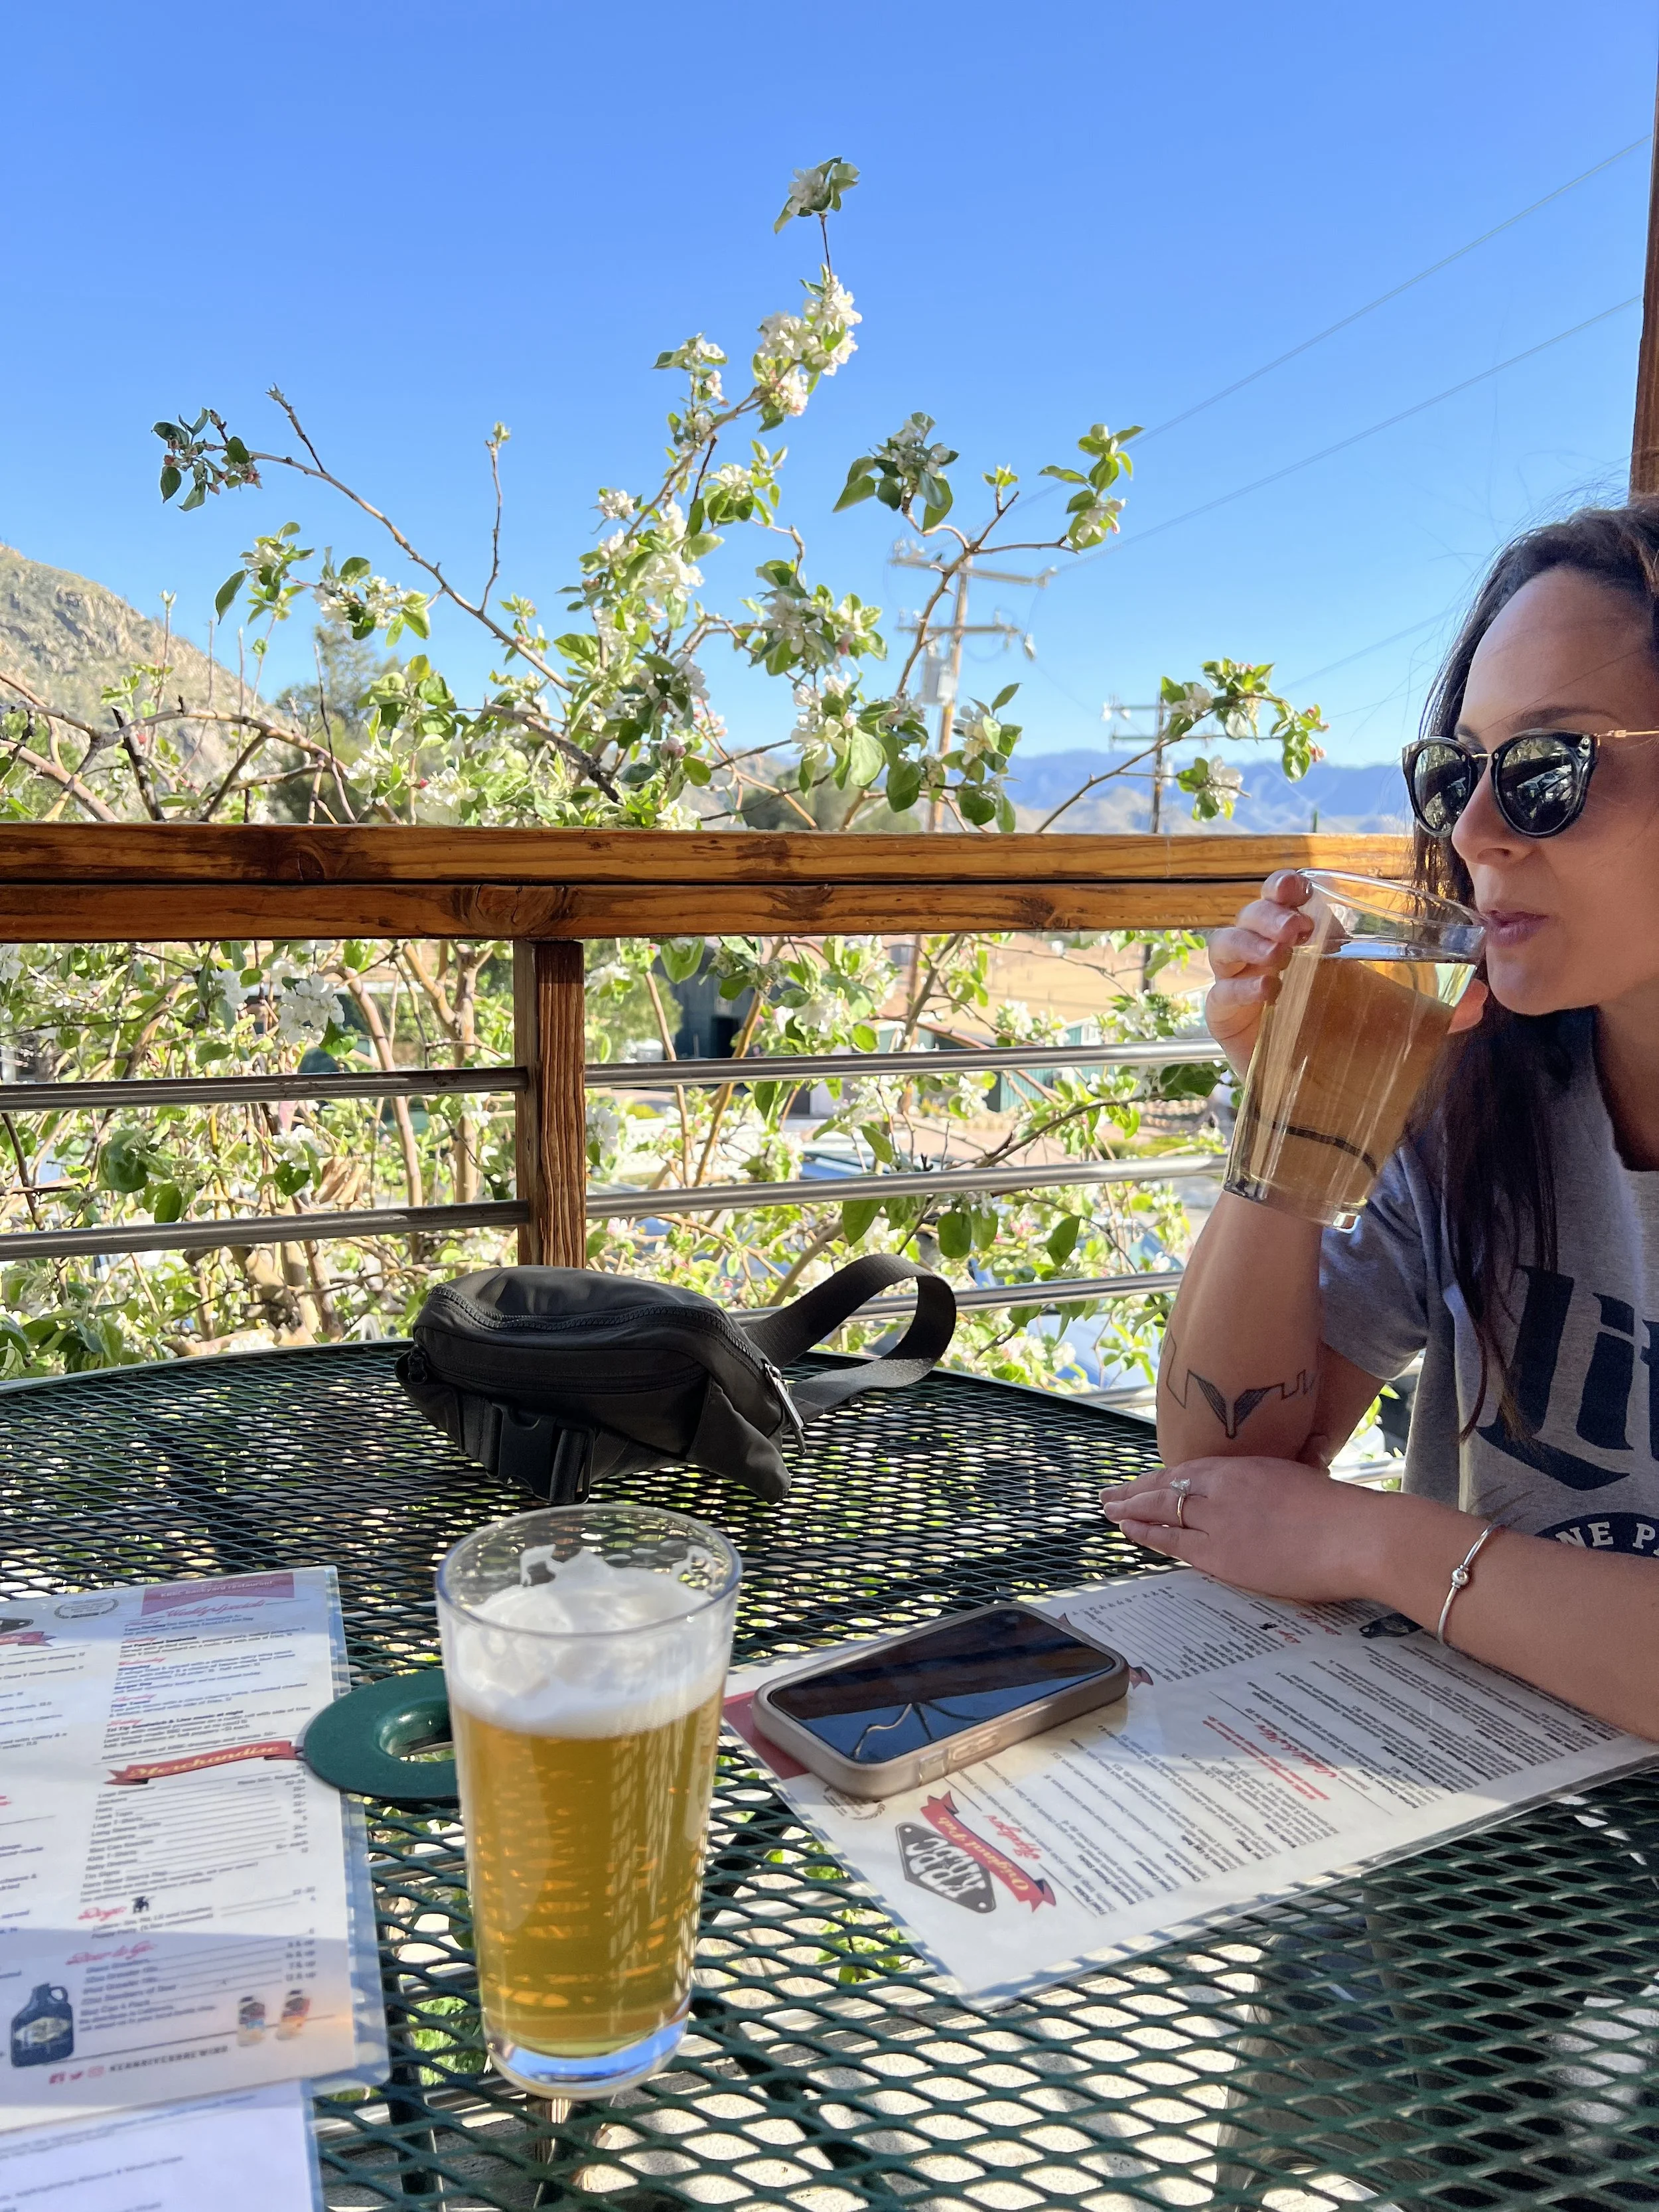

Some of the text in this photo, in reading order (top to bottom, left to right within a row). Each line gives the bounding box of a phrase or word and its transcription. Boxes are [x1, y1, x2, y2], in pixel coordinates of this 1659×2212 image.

[1477, 1266, 1659, 1491] Li
[1632, 1523, 1659, 1556] P
[228, 1581, 273, 1589] restaurant
[210, 1599, 265, 1614] Specials
[127, 1745, 281, 1777] Merchandise
[905, 1837, 986, 1898] KRBC
[938, 1817, 1029, 1890] Original Pub
